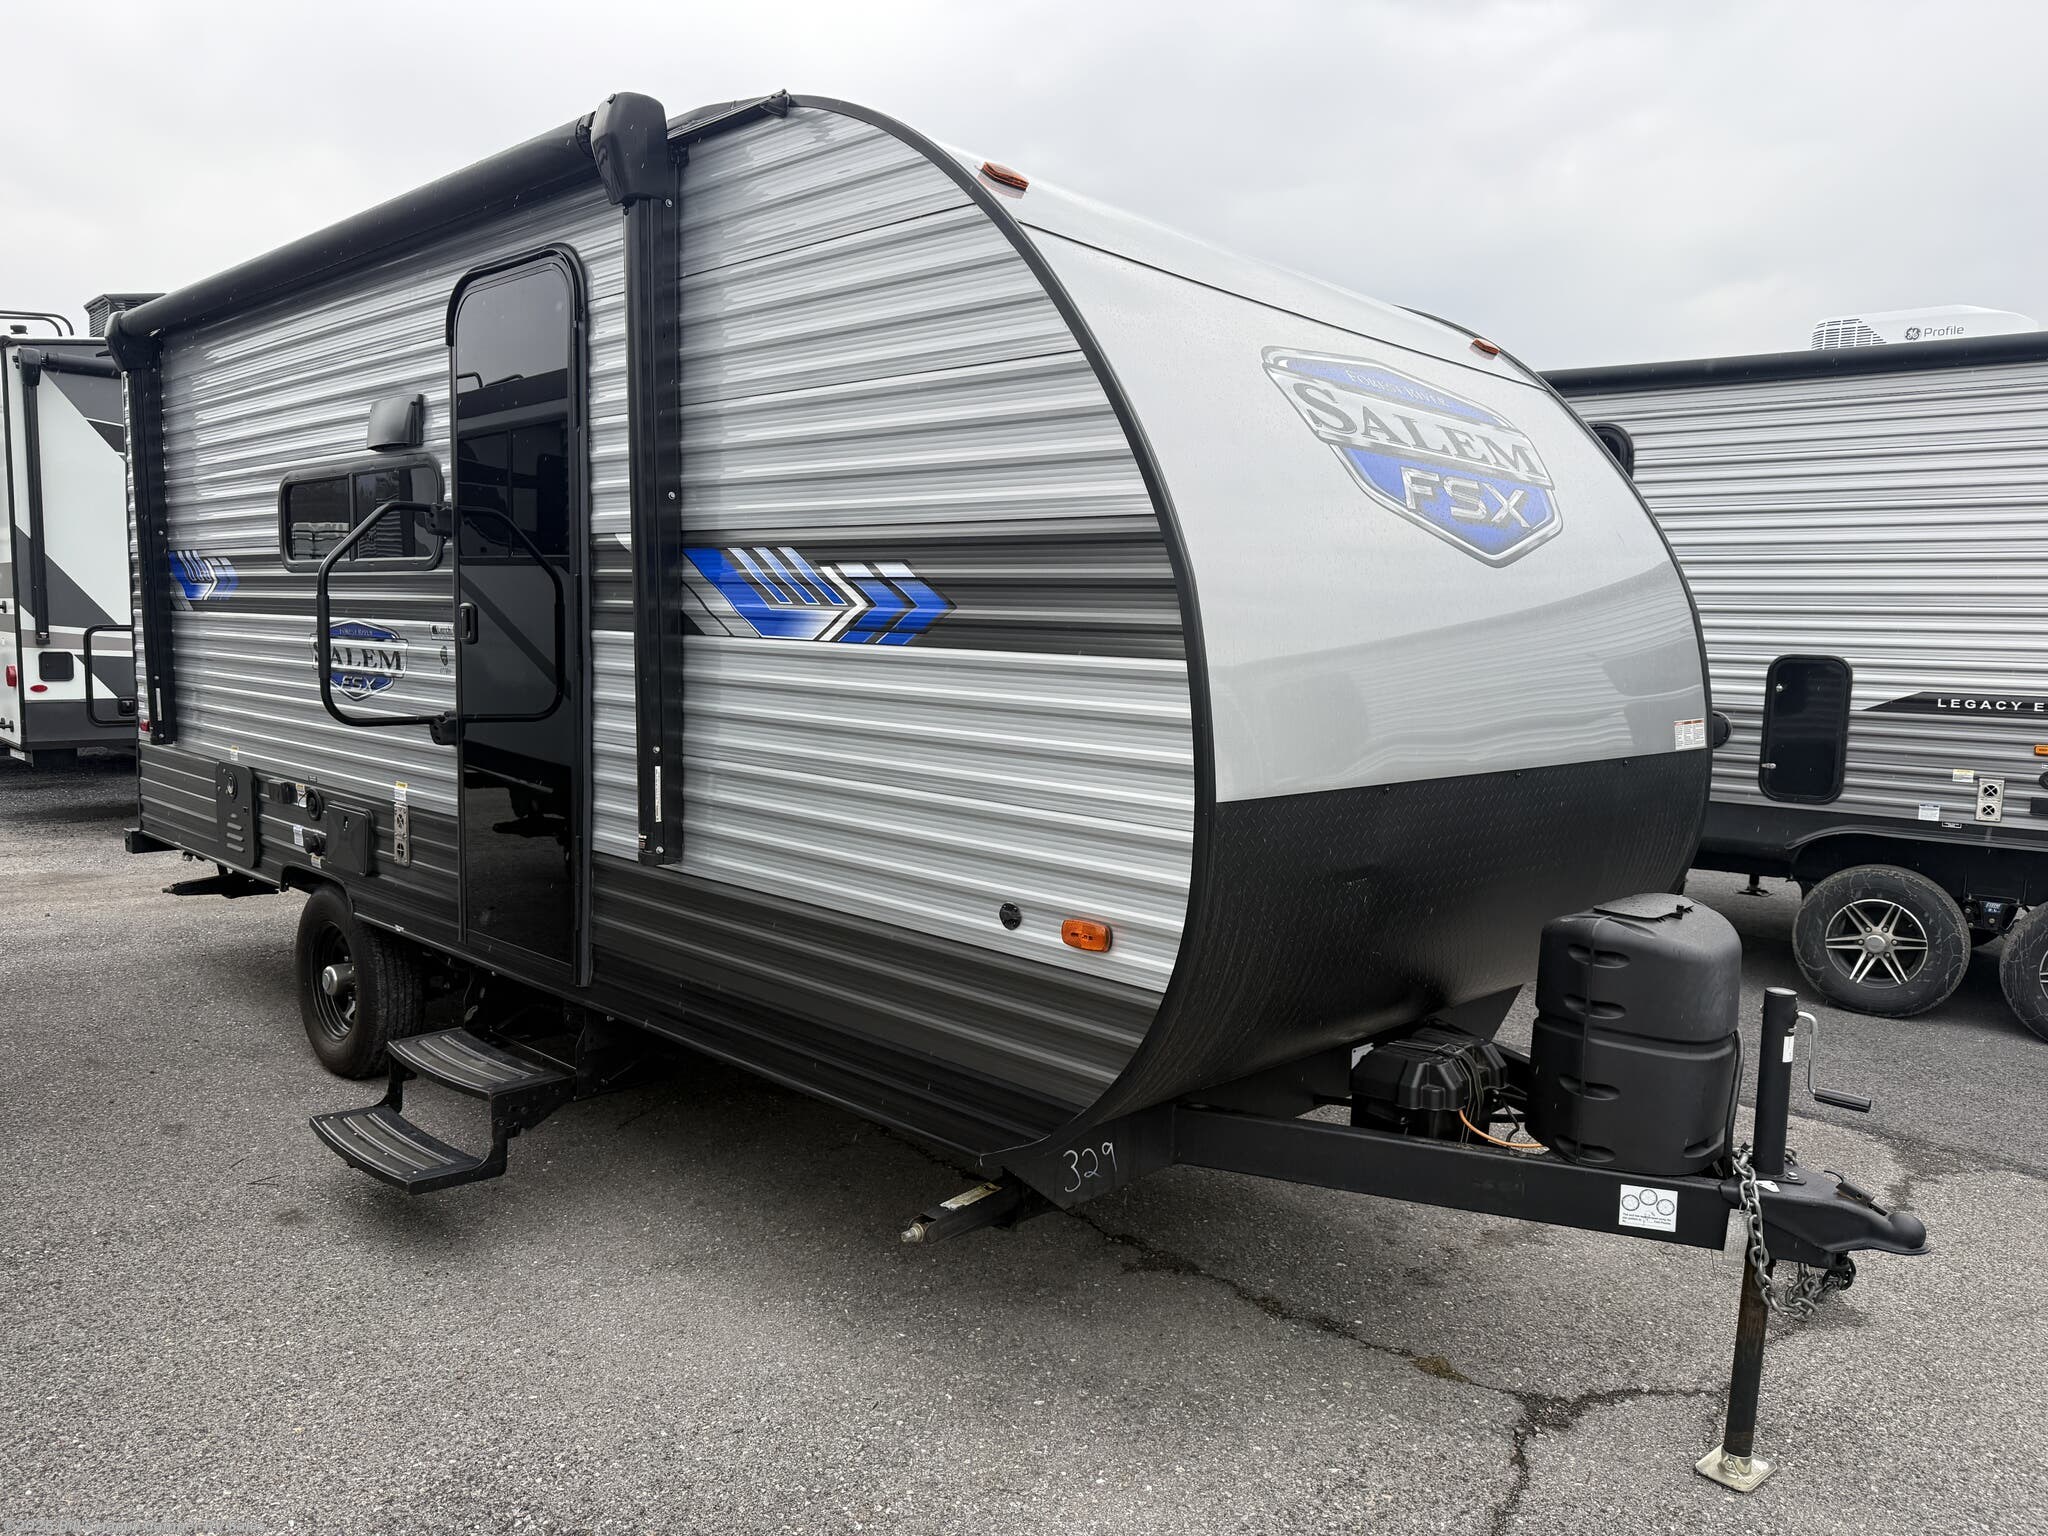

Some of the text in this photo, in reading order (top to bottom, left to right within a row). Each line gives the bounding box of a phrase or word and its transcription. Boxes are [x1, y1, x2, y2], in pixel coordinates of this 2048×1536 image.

[1924, 325, 1965, 337] Profile
[1292, 382, 1547, 478] SALEM
[1400, 466, 1531, 529] FSX
[340, 675, 377, 694] FSX
[1937, 698, 2023, 711] LEGACY
[1062, 1141, 1118, 1193] 329
